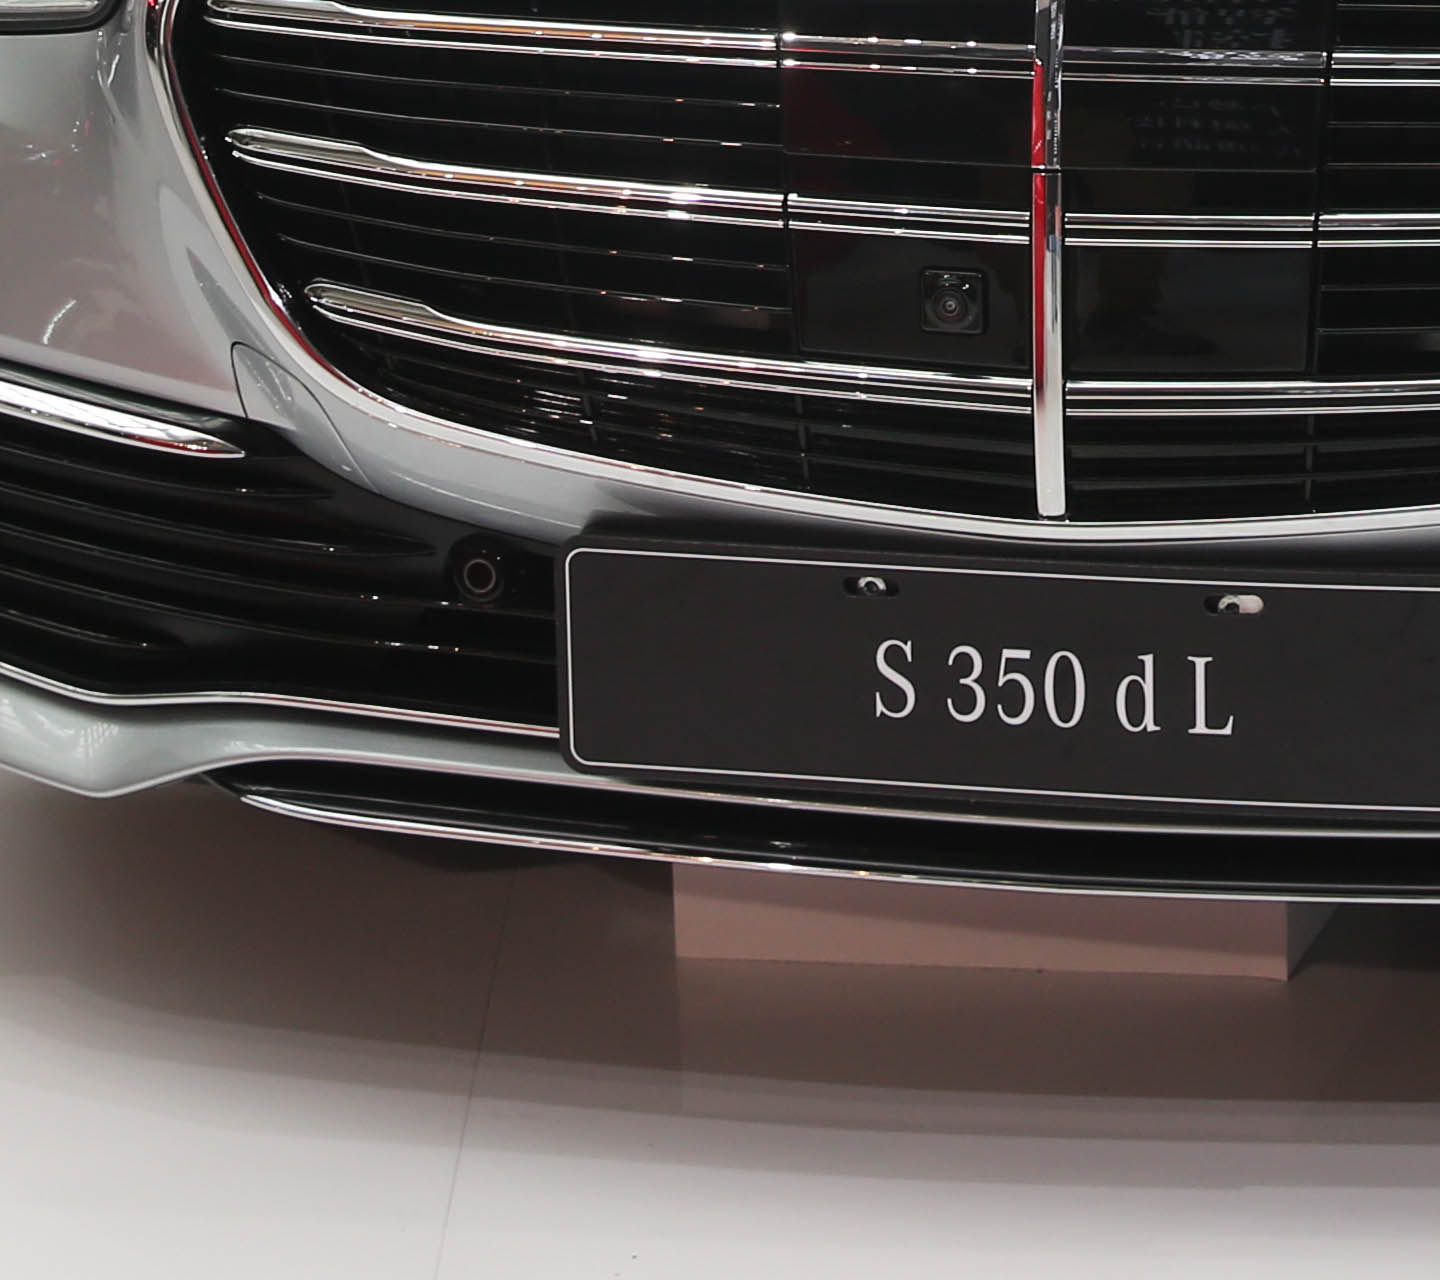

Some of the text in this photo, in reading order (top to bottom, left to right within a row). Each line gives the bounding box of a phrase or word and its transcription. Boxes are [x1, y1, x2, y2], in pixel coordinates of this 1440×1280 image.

[874, 638, 1235, 736] S 350 d L
